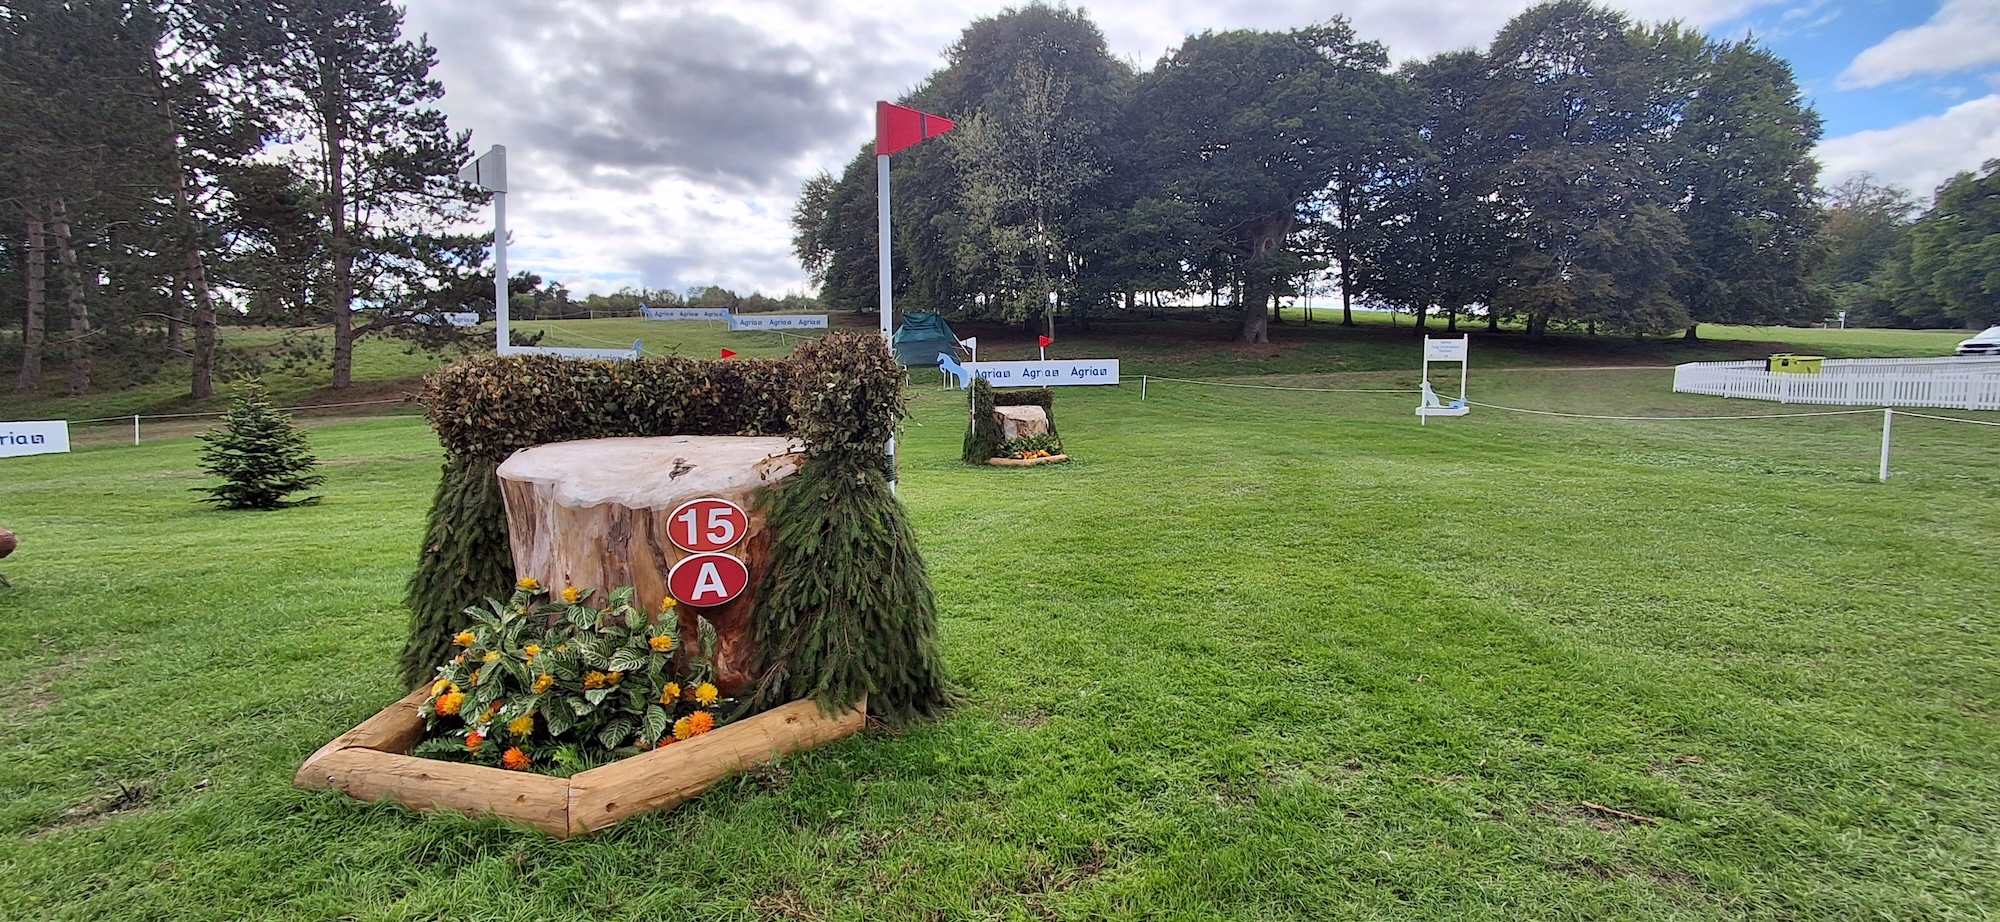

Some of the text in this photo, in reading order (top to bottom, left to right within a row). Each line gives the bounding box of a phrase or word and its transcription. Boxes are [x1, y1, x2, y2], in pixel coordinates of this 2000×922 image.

[1022, 367, 1051, 380] Agra
[1070, 366, 1099, 379] Agria
[678, 507, 735, 545] 15
[691, 561, 728, 600] A
